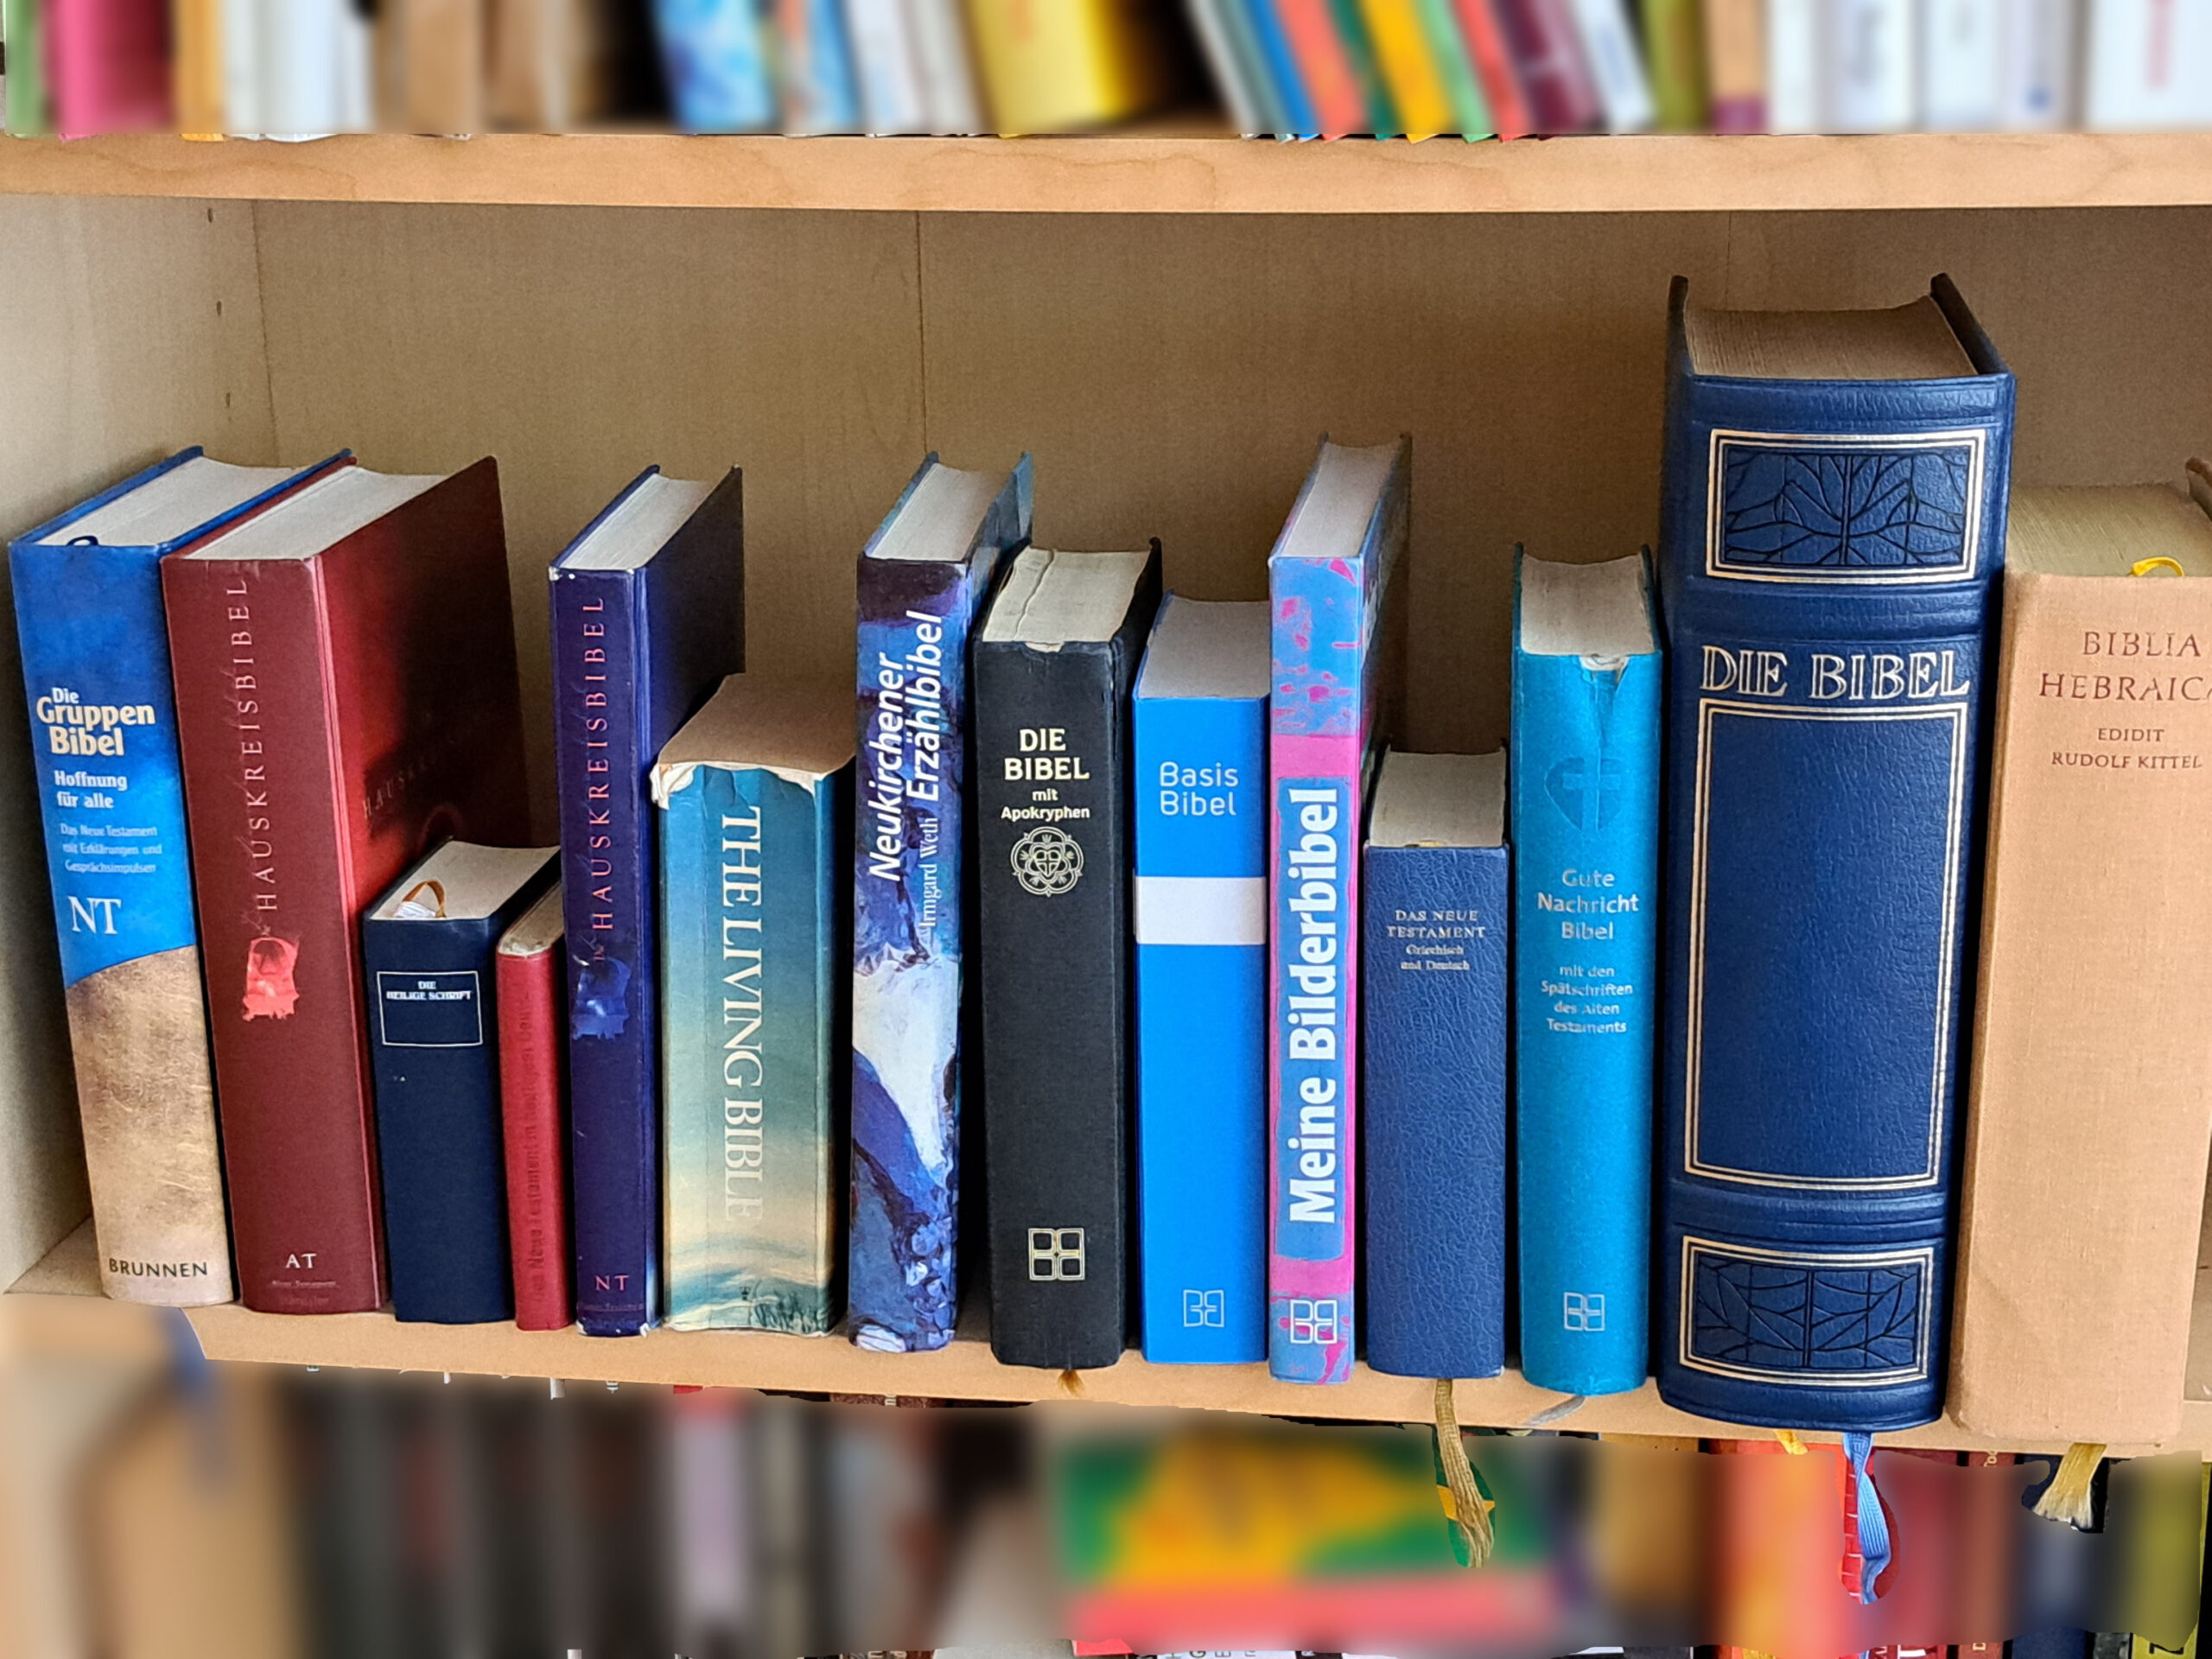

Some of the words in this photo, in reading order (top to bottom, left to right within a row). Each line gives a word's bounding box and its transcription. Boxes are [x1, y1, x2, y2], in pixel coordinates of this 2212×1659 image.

[2083, 631, 2201, 658] BIBLIA
[1700, 645, 1788, 696] DIE
[1810, 649, 1971, 701] BIBEL
[52, 687, 79, 704] Die
[905, 610, 943, 802] Erzählbibel
[36, 696, 156, 731] Gruppen
[49, 727, 124, 756] Bibel
[226, 579, 278, 910] HAUSKREISBIBEL
[1020, 728, 1066, 752] DIE
[2098, 728, 2165, 742] EDIDIT
[582, 597, 614, 931] HAUSKREISBIBEL
[868, 652, 904, 881] Neukirchener
[1004, 757, 1090, 780] BIBEL
[2051, 751, 2132, 769] RUDOLF
[2138, 755, 2202, 770] KITTEL
[54, 770, 127, 791] Hoffnung
[1159, 761, 1239, 787] Basis
[57, 791, 79, 809] für
[84, 793, 114, 809] alle
[1032, 788, 1058, 802] mit
[1160, 791, 1236, 817] Bibel
[1001, 805, 1090, 822] Apokryphen
[918, 817, 938, 858] Weth
[721, 805, 762, 907] THE
[1561, 868, 1615, 888] Gute
[918, 864, 943, 928] Irmgard
[1537, 892, 1639, 913] Nachricht
[67, 896, 122, 935] NT
[1287, 788, 1338, 1060] Bilderbibel
[1395, 910, 1427, 922] DAS
[1433, 910, 1479, 922] NEUE
[1387, 925, 1485, 939] TESTAMENT
[1561, 921, 1614, 940] Bibel
[1560, 964, 1584, 977] mit
[1587, 964, 1615, 977] den
[417, 980, 436, 990] DIE
[1541, 980, 1634, 998] Spätschriften
[721, 918, 764, 1088] LIVING
[1554, 1001, 1578, 1014] des
[1582, 1003, 1620, 1015] Alten
[1547, 1018, 1627, 1034] Testaments
[723, 1097, 764, 1222] BIBLE
[1287, 1076, 1337, 1224] Meine
[109, 1258, 208, 1277] BRUNNEN
[285, 1253, 317, 1269] AT
[594, 1274, 629, 1291] NT
